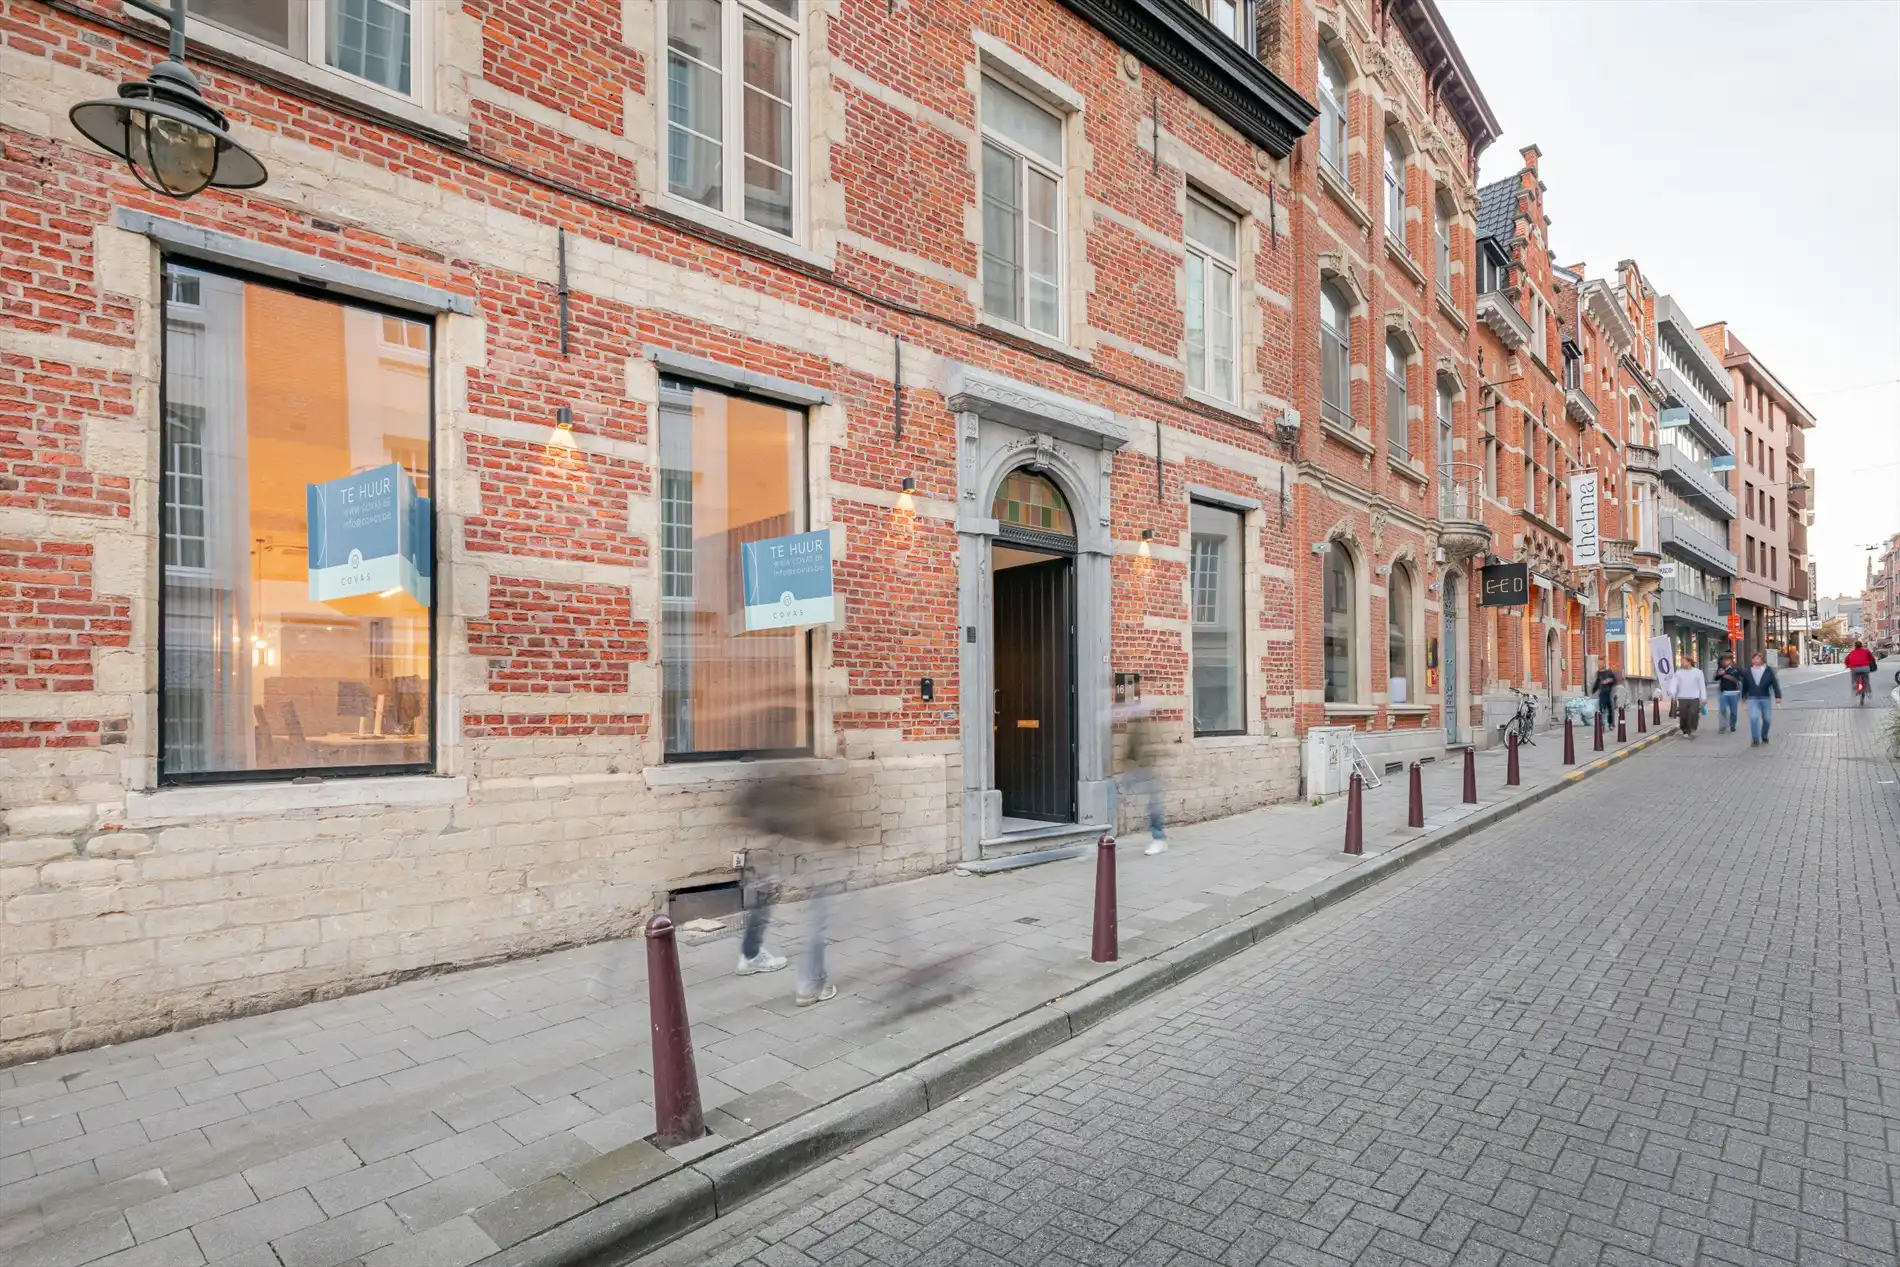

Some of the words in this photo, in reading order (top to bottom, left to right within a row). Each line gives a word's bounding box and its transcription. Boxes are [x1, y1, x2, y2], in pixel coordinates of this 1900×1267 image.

[340, 486, 354, 504] TE
[360, 478, 391, 499] HUUR
[1576, 480, 1595, 559] thelma
[769, 545, 785, 559] TE
[790, 539, 823, 555] HUUR
[341, 573, 371, 586] COVAS
[773, 609, 804, 619] COVAS
[1116, 684, 1125, 694] 16
